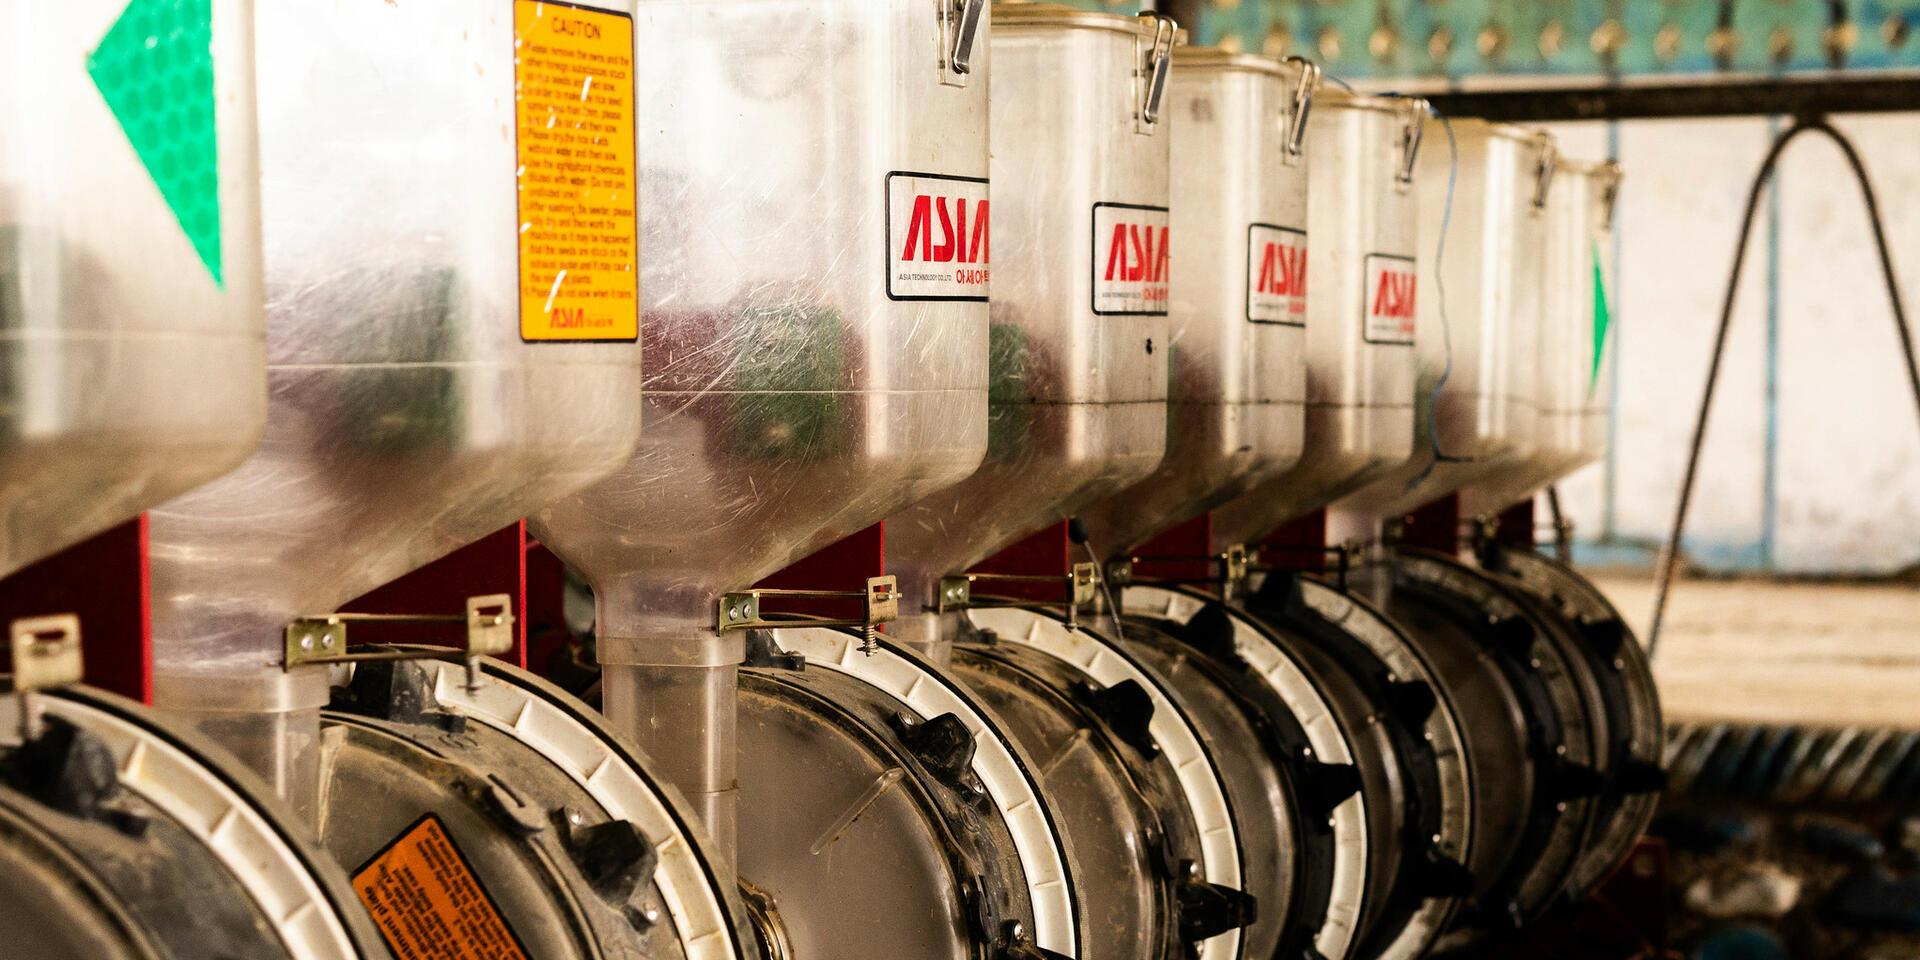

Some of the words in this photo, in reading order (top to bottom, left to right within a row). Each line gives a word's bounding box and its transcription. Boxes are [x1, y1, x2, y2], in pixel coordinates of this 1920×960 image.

[552, 16, 601, 40] CAUTION
[901, 194, 990, 264] ASIA
[1104, 223, 1169, 283] ASIA
[899, 273, 912, 281] ASIA
[550, 307, 584, 329] ASIA
[362, 884, 388, 916] plate
